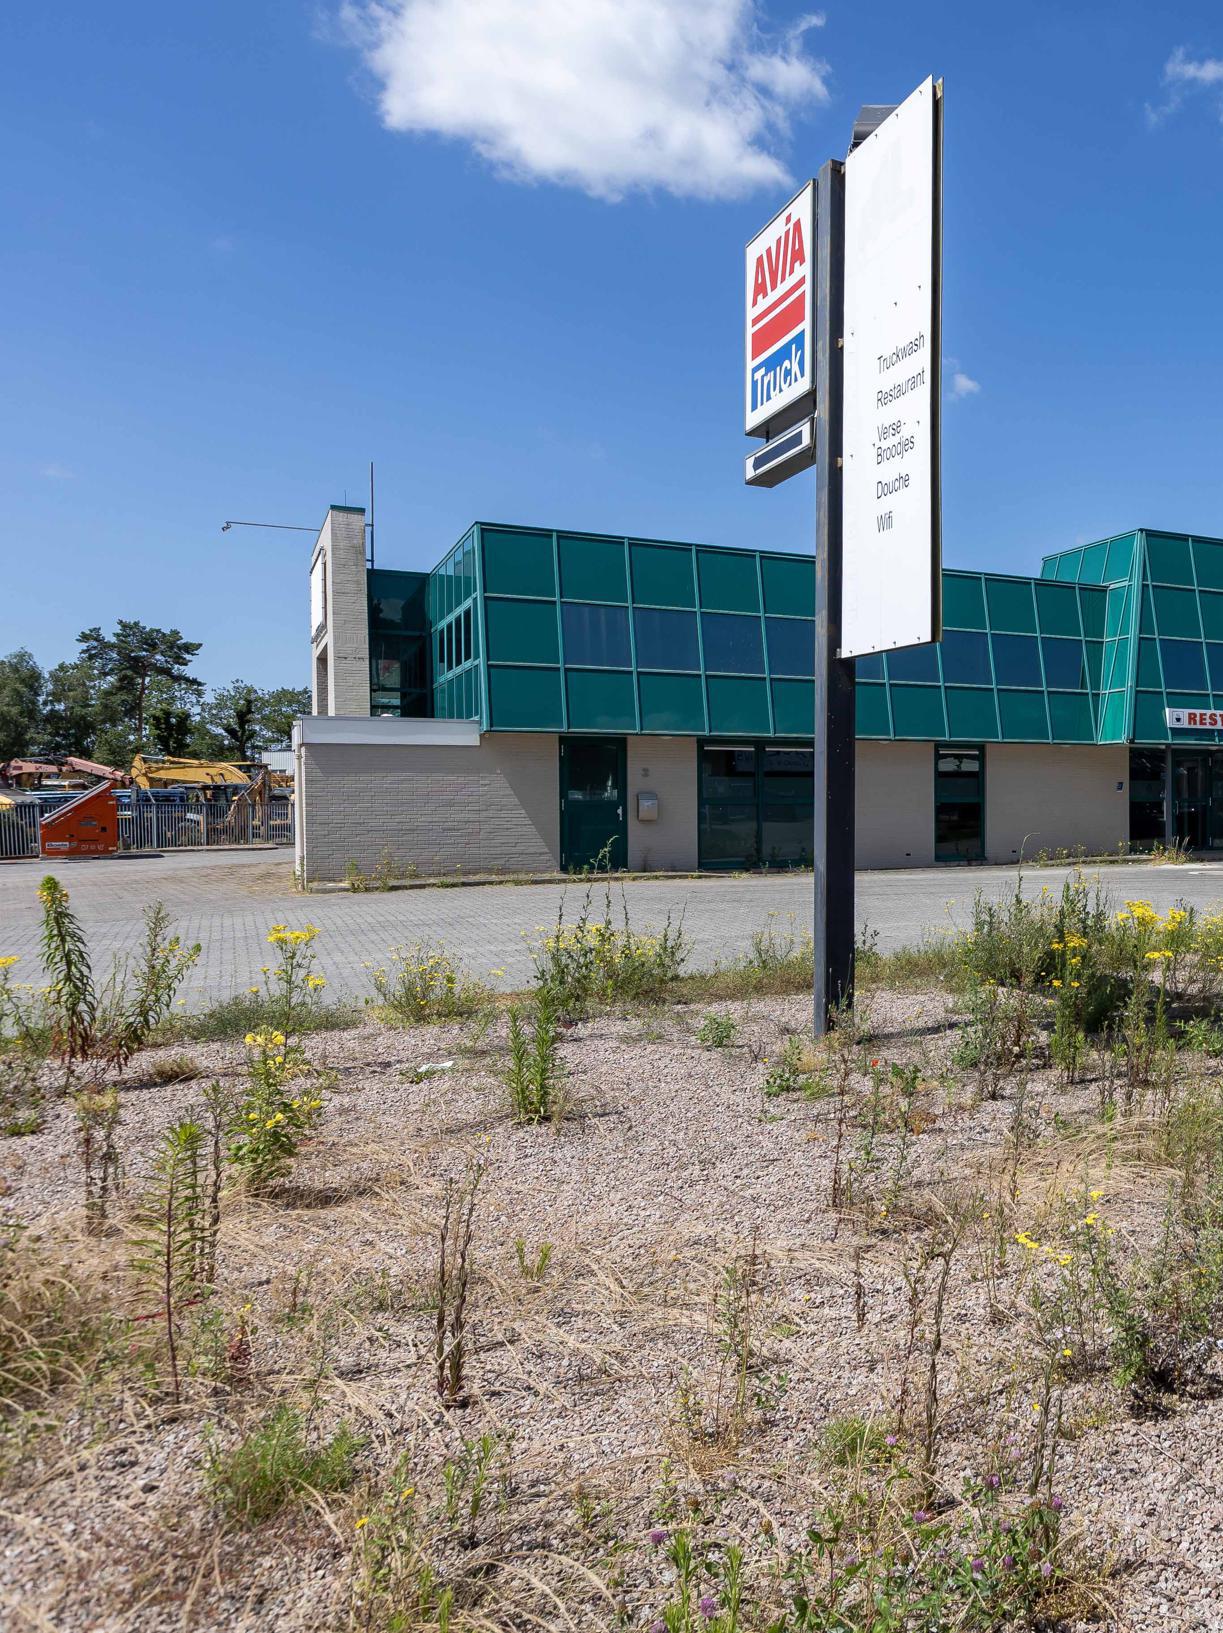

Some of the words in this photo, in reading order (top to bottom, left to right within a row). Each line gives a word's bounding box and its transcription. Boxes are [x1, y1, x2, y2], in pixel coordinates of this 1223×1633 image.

[751, 212, 806, 308] AVIA
[877, 331, 925, 375] Truckwash
[753, 345, 803, 410] Truck
[876, 368, 926, 409] Restaurant
[876, 434, 915, 465] Broodjes
[876, 471, 910, 500] Douche
[876, 510, 894, 534] Wifi
